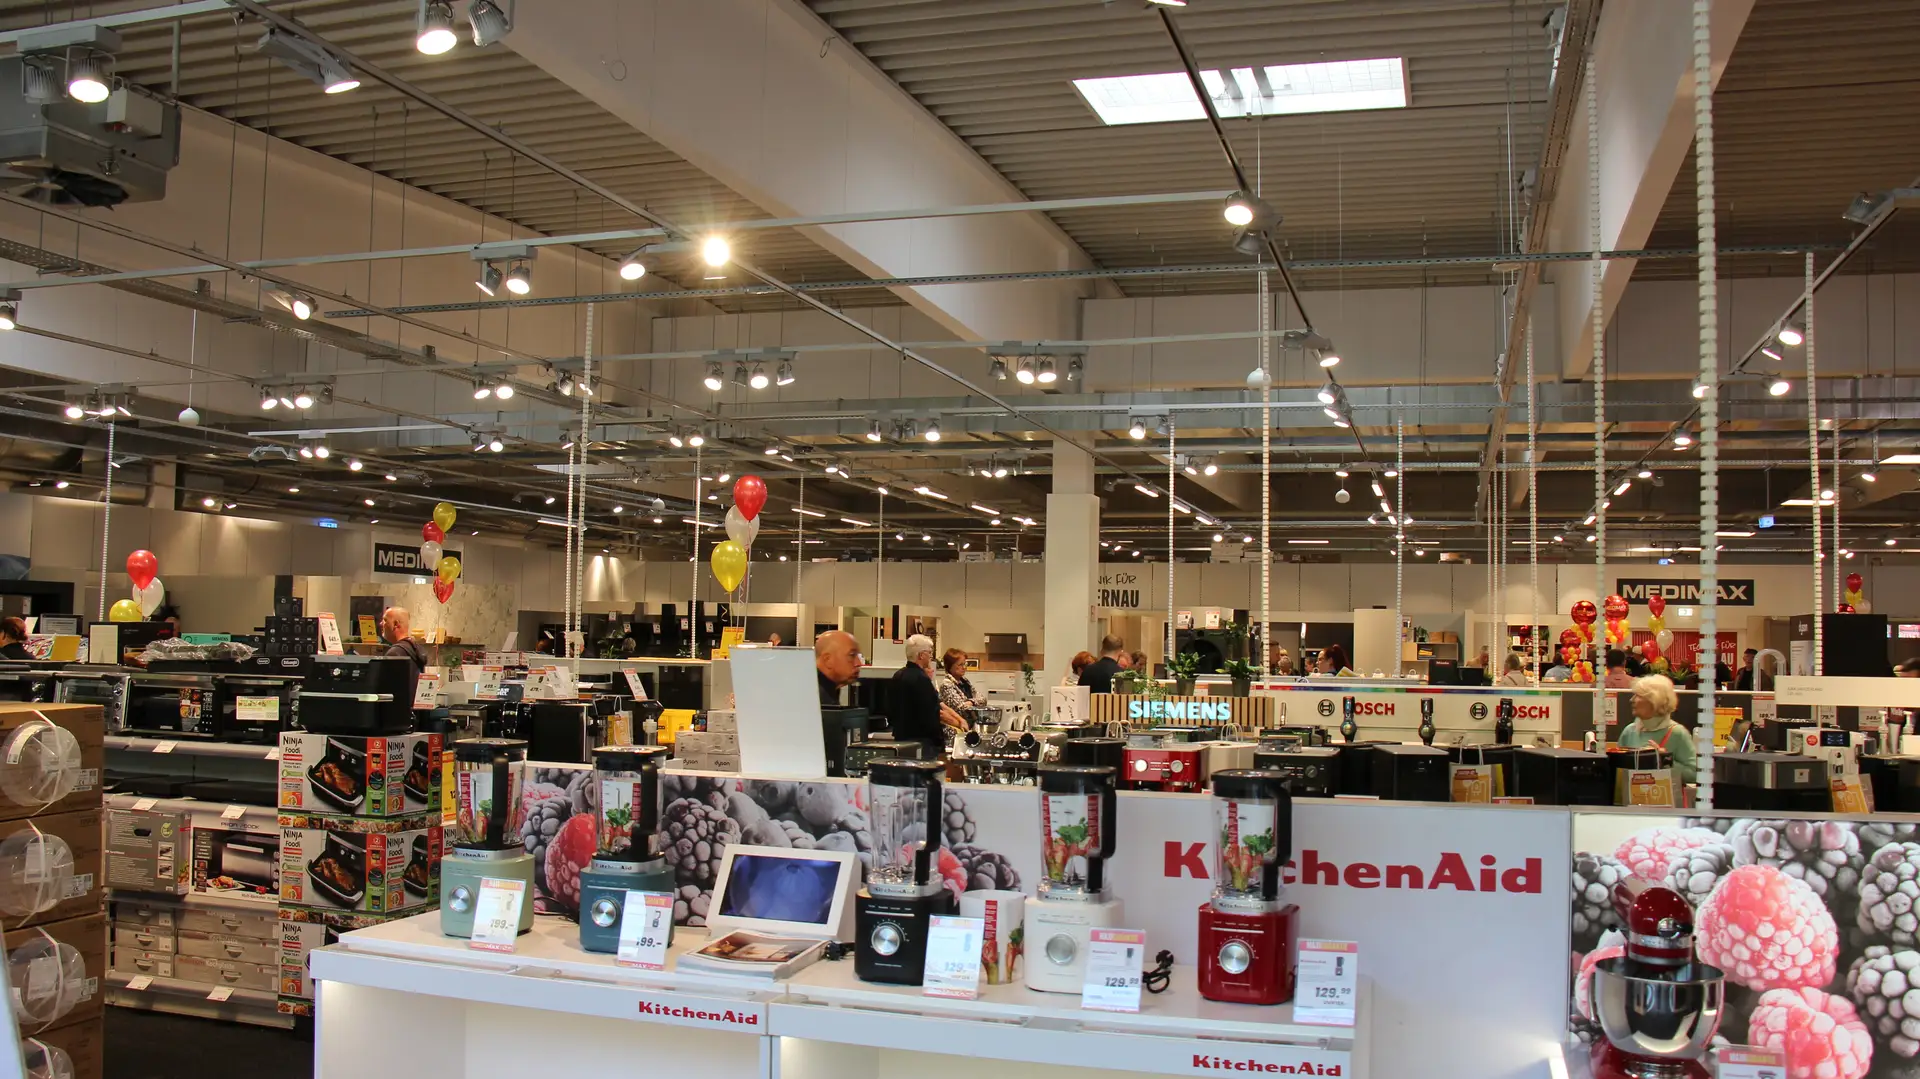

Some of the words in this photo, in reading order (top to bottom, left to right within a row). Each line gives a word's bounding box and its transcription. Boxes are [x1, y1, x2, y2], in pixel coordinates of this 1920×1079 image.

[378, 549, 431, 570] MEDI
[1115, 572, 1137, 585] FÜR
[1622, 584, 1748, 601] MEDIMAX
[1128, 700, 1231, 720] SIEMENS
[1353, 701, 1395, 716] OSCH
[282, 735, 303, 748] NINJA
[387, 740, 405, 753] NINJA
[285, 746, 301, 754] Foodi
[389, 753, 404, 761] Foodi
[683, 758, 698, 766] dyson
[283, 828, 303, 840] NINJA
[285, 840, 301, 848] Foodi
[386, 836, 405, 849] NINJA
[388, 849, 404, 857] Foodi
[455, 850, 489, 859] KitchenAid
[595, 862, 633, 871] KitchenAid
[1164, 840, 1543, 894] KhenAid
[282, 922, 302, 935] NINJA
[284, 933, 300, 942] Foodi
[1104, 976, 1140, 988] 129.99
[1314, 986, 1352, 999] 129.99
[638, 1001, 758, 1025] KitchenAid
[1192, 1054, 1342, 1077] KitchenAid
